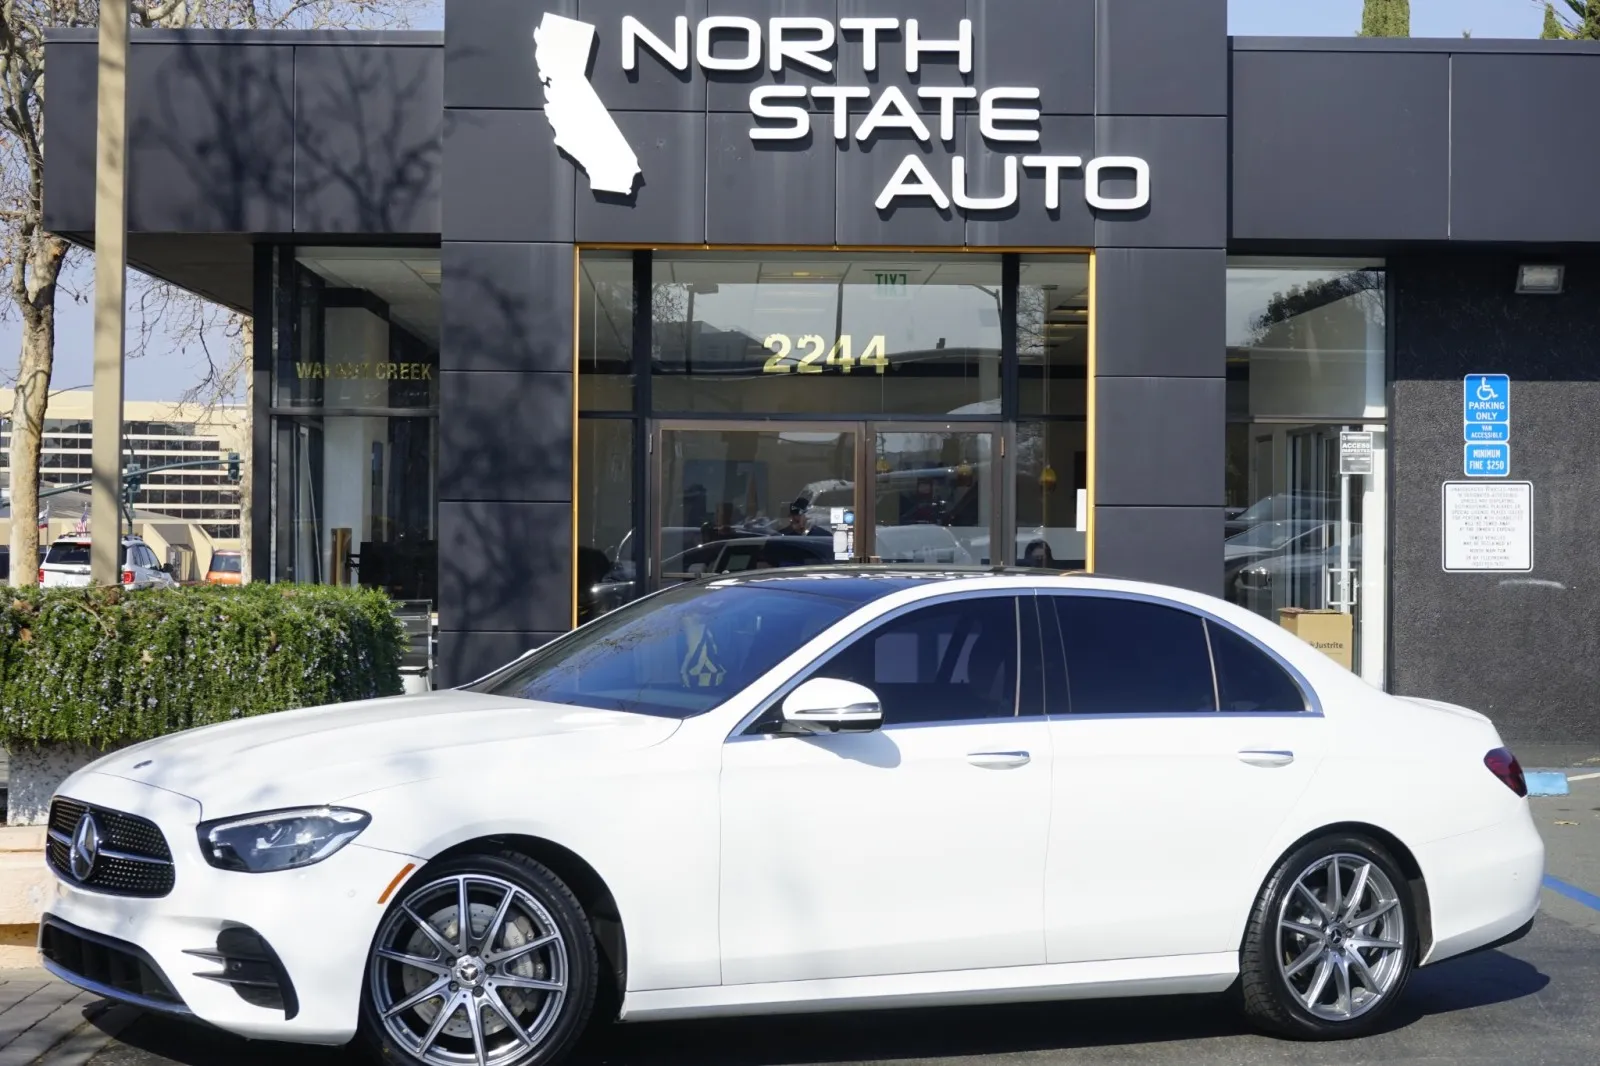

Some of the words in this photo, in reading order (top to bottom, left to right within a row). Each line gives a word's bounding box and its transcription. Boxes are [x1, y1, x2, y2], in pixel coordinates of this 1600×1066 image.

[621, 16, 972, 73] NORTH
[749, 86, 1040, 141] STATE
[875, 154, 1151, 211] AUTO
[763, 333, 889, 374] 2244
[375, 362, 432, 381] CREEK
[1469, 401, 1505, 410] PARKING
[1476, 412, 1498, 420] ONLY
[1473, 449, 1500, 458] MINIMUM
[1470, 461, 1483, 470] FINE
[1487, 460, 1504, 470] $250
[1315, 641, 1343, 649] Justrite
